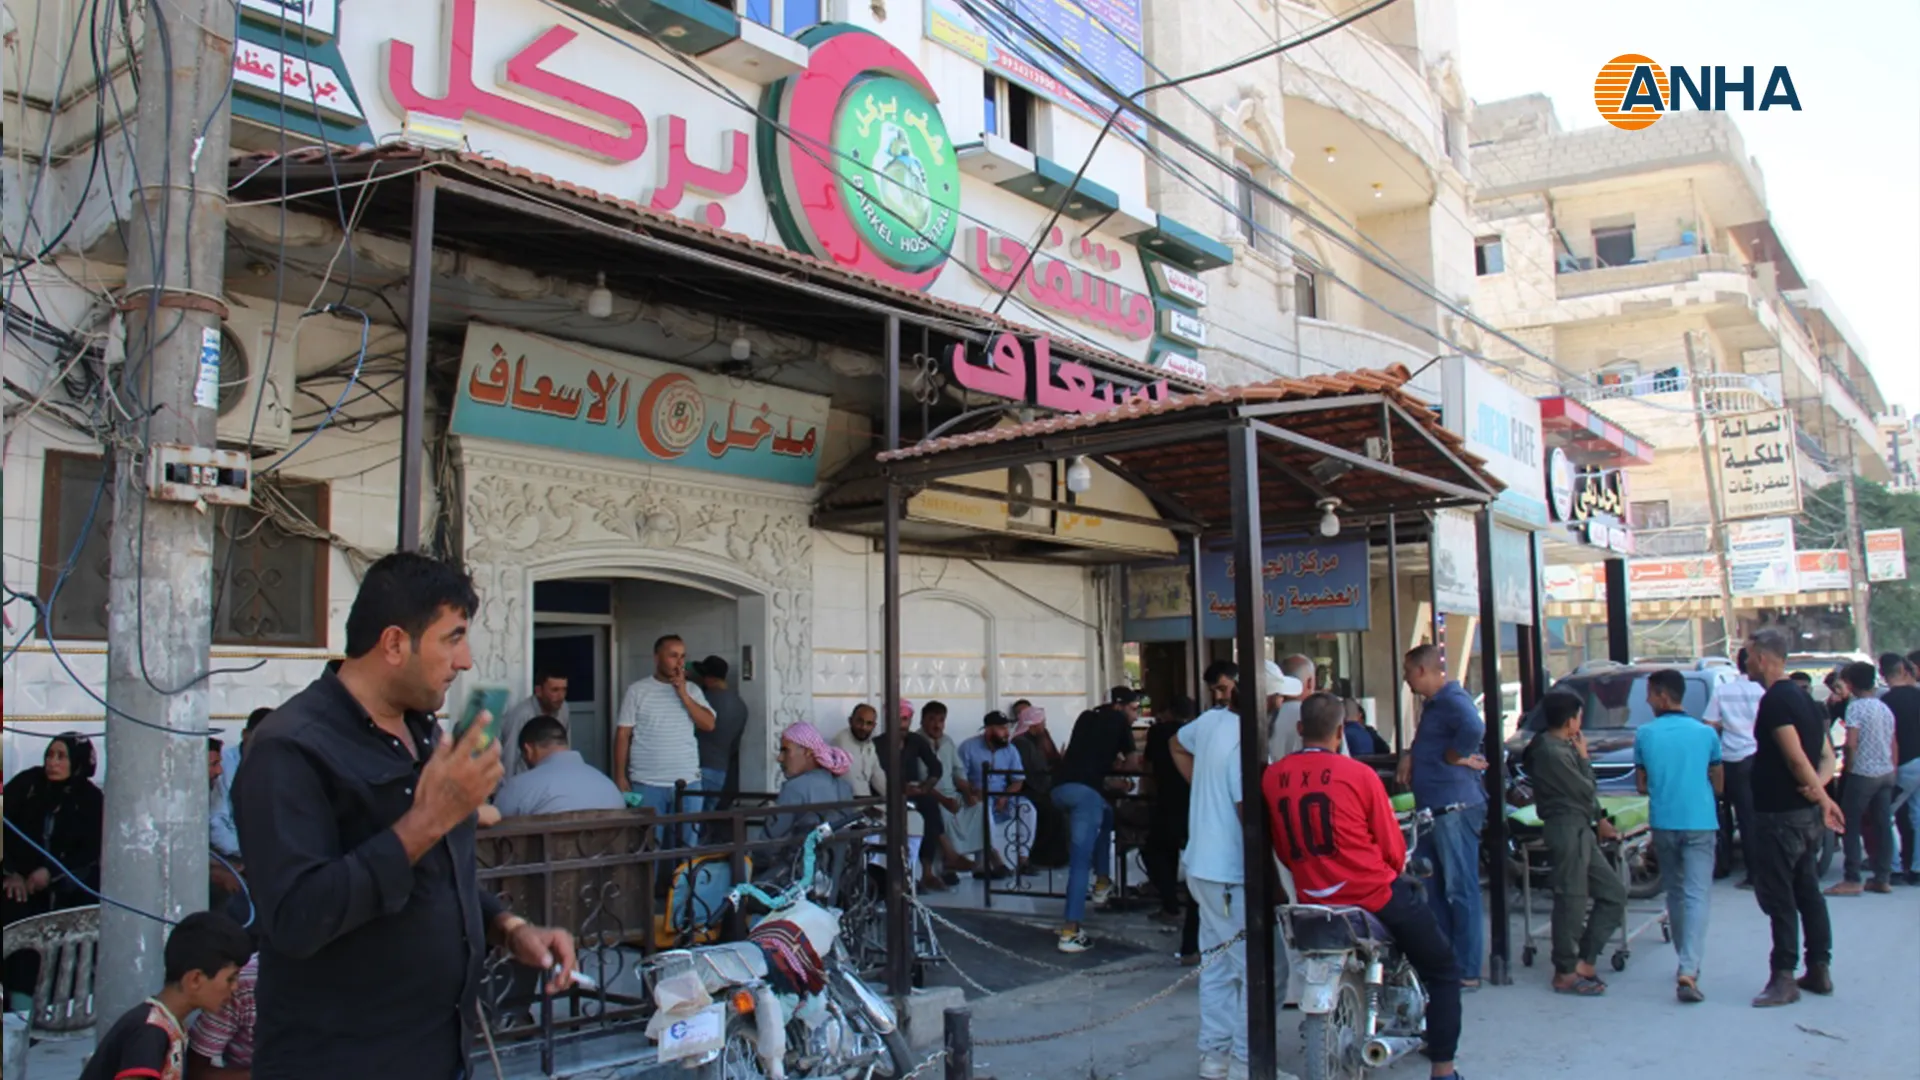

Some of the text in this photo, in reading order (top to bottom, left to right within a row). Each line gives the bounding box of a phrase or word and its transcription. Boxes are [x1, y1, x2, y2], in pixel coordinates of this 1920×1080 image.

[389, 0, 1155, 341] مشفى بركل
[900, 208, 951, 253] HOSPITAL
[468, 342, 818, 457] مدخل الاسعاف
[1510, 416, 1537, 469] CAFE
[1718, 414, 1789, 439] الصالة
[1722, 443, 1791, 475] الملكية
[1728, 475, 1790, 496] للمفروشات
[1294, 549, 1339, 577] مركز
[1278, 792, 1336, 862] 10
